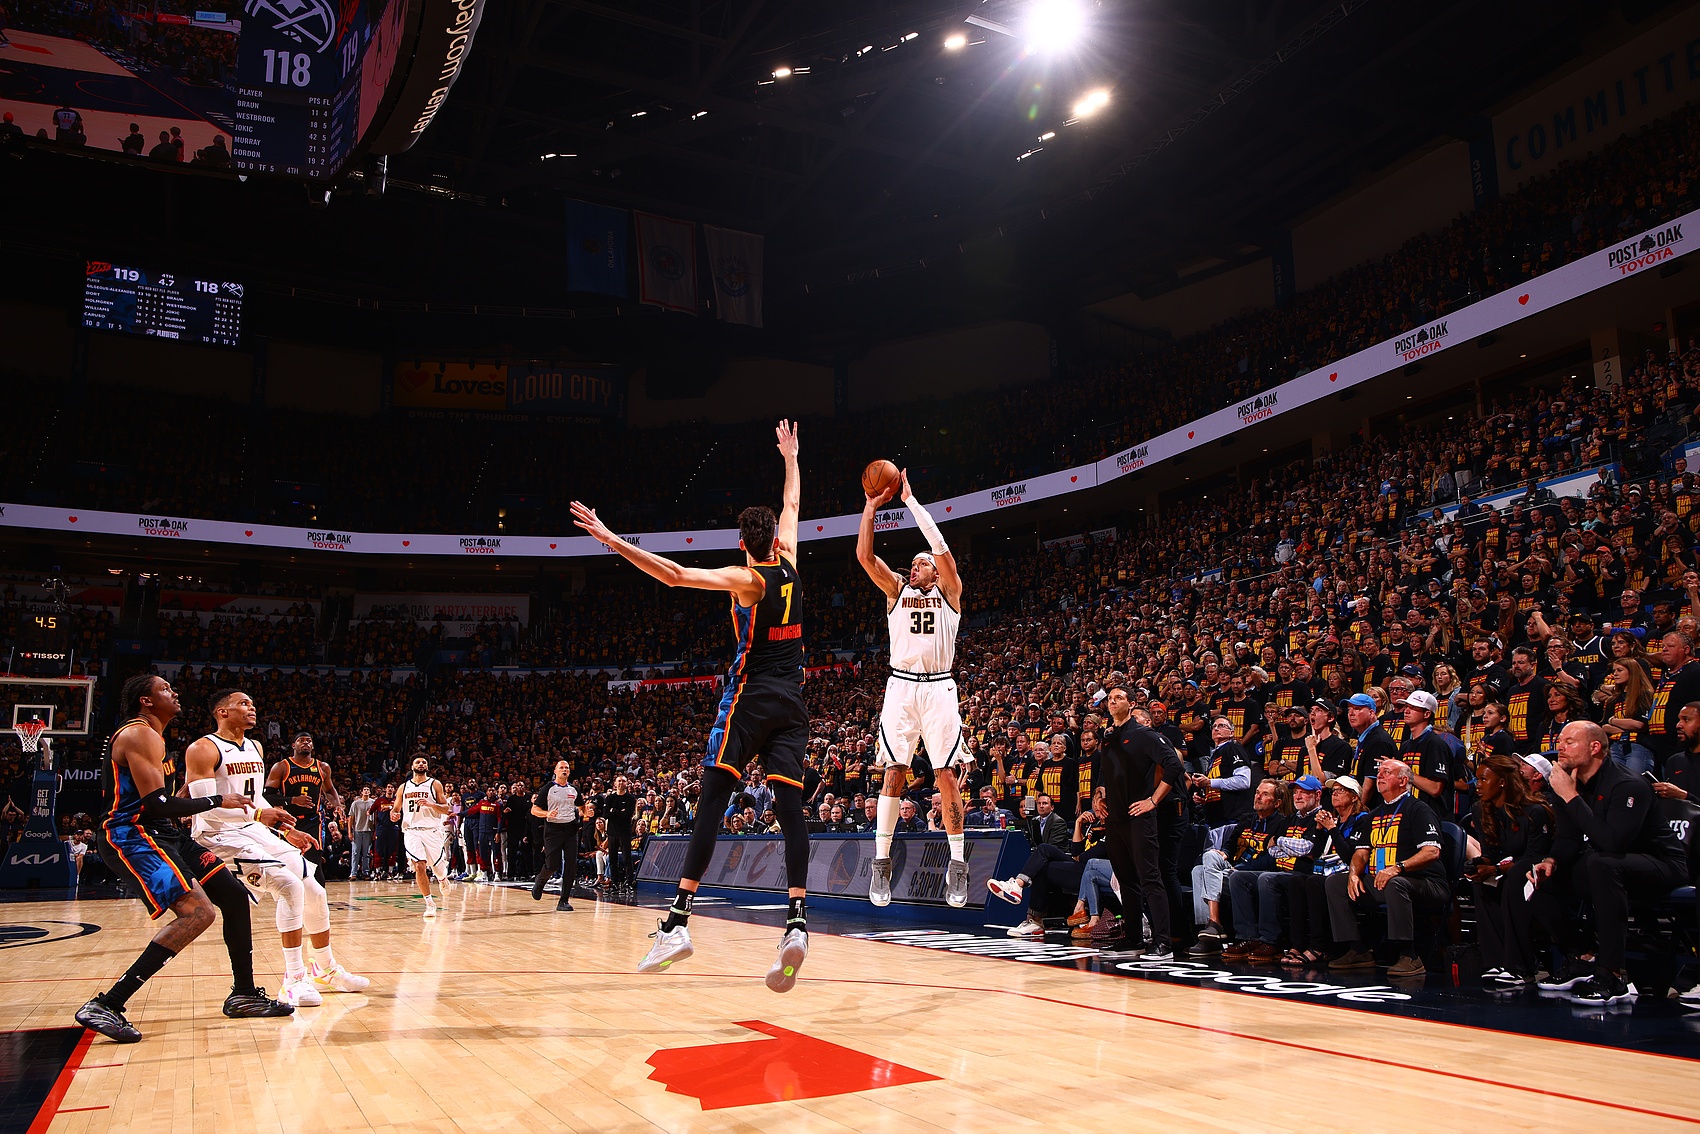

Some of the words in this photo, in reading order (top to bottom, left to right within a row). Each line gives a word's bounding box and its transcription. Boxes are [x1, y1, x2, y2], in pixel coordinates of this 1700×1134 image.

[439, 0, 476, 81] paycom
[342, 30, 359, 79] 119
[262, 49, 312, 87] 118
[239, 88, 262, 98] PLAYER
[309, 97, 321, 105] PTS
[237, 100, 259, 109] BRAUN
[410, 86, 448, 134] center
[235, 112, 275, 123] WESTBROOK
[310, 121, 318, 129] 18
[234, 123, 253, 133] JOKIC
[309, 133, 318, 141] 42
[234, 136, 261, 146] MURRAY
[233, 148, 260, 158] GORDON
[308, 157, 316, 165] 19
[237, 161, 246, 169] TO
[248, 162, 253, 170] 0
[269, 165, 275, 173] 5
[286, 166, 299, 175] 4TH
[309, 169, 320, 178] 4.7
[1608, 242, 1638, 267] POST
[1656, 224, 1684, 247] OAK
[1619, 247, 1675, 275] TOYOTA
[114, 268, 139, 281] 119
[158, 279, 175, 287] 4.7
[194, 280, 219, 294] 118
[85, 298, 114, 306] HOLMGREN
[165, 303, 198, 311] WESTBROOK
[1394, 333, 1416, 355] POST
[1429, 321, 1449, 343] OAK
[1402, 341, 1441, 361] TOYOTA
[433, 374, 505, 396] Loves
[512, 373, 563, 405] LOUD
[570, 374, 612, 407] CITY
[1238, 402, 1255, 418] POST
[1263, 392, 1278, 408] OAK
[407, 411, 444, 420] BRING
[448, 412, 470, 420] THE
[474, 412, 529, 422] THUNDER
[547, 415, 572, 423] EXIT
[575, 417, 601, 425] NOW
[1243, 408, 1273, 424] TOYOTA
[1116, 453, 1131, 468] POST
[1137, 445, 1148, 460] OAK
[1121, 459, 1144, 474] TOYOTA
[992, 491, 1006, 502] POST
[1014, 483, 1026, 495] OAK
[996, 495, 1022, 508] TOYOTA
[891, 510, 905, 521] OAK
[139, 518, 160, 528] POST
[171, 521, 188, 531] OAK
[145, 528, 181, 538] TOYOTA
[307, 532, 327, 543] POST
[336, 535, 352, 546] OAK
[313, 541, 345, 551] TOYOTA
[460, 539, 476, 548] POST
[487, 540, 501, 548] OAK
[465, 547, 494, 555] TOYOTA
[781, 581, 794, 625] 7
[902, 597, 942, 610] NUGGETS
[411, 605, 430, 617] OAK
[433, 605, 466, 618] PARTY
[471, 605, 517, 618] TERRACE
[34, 616, 58, 630] 4.5
[460, 623, 475, 632] POST
[910, 611, 935, 635] 32
[33, 653, 66, 661] TISSOT
[225, 761, 264, 776] NUGGETS
[289, 774, 321, 786] OKLAHOMA
[37, 789, 50, 798] GET
[244, 778, 255, 802] 4
[301, 786, 309, 796] 5
[405, 791, 429, 800] NUGGETS
[36, 798, 48, 807] THE
[38, 808, 50, 818] App
[25, 831, 53, 840] Google
[11, 853, 61, 866] KIA
[908, 871, 942, 898] 9:30PM
[1115, 961, 1412, 1003] Google
